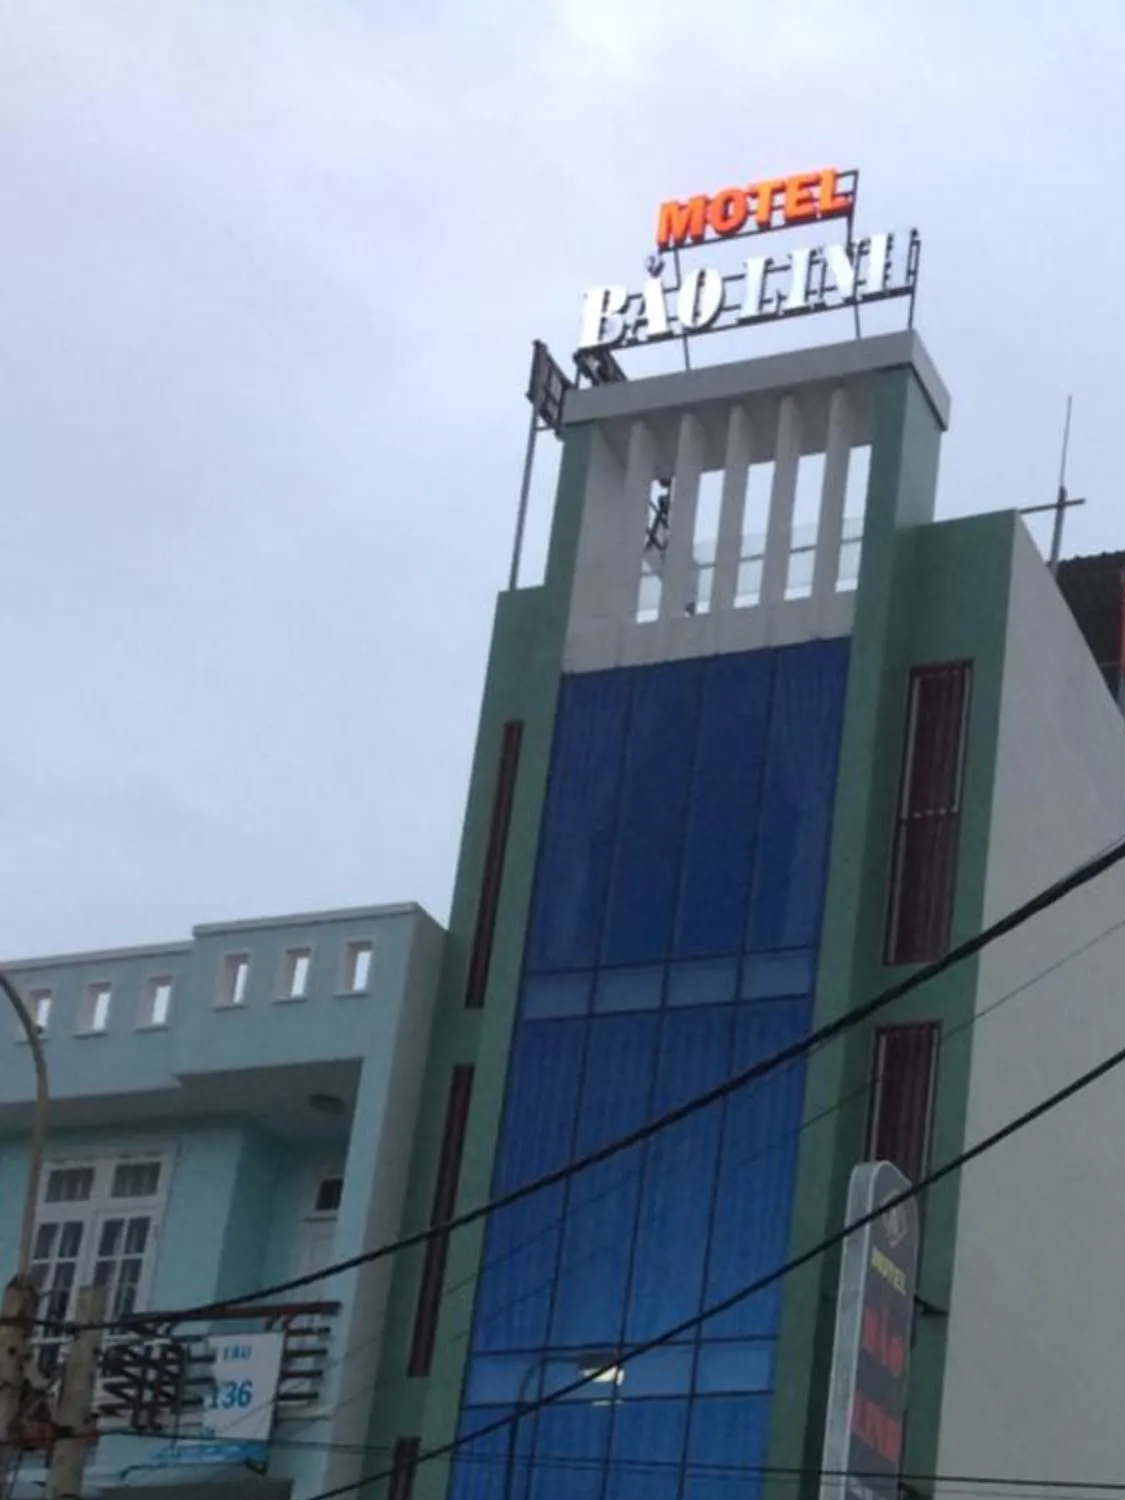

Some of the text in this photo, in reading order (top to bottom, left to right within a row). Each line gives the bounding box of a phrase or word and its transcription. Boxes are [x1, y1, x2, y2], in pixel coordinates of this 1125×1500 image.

[655, 168, 853, 248] MOTEL
[578, 230, 919, 350] BẢO LINH
